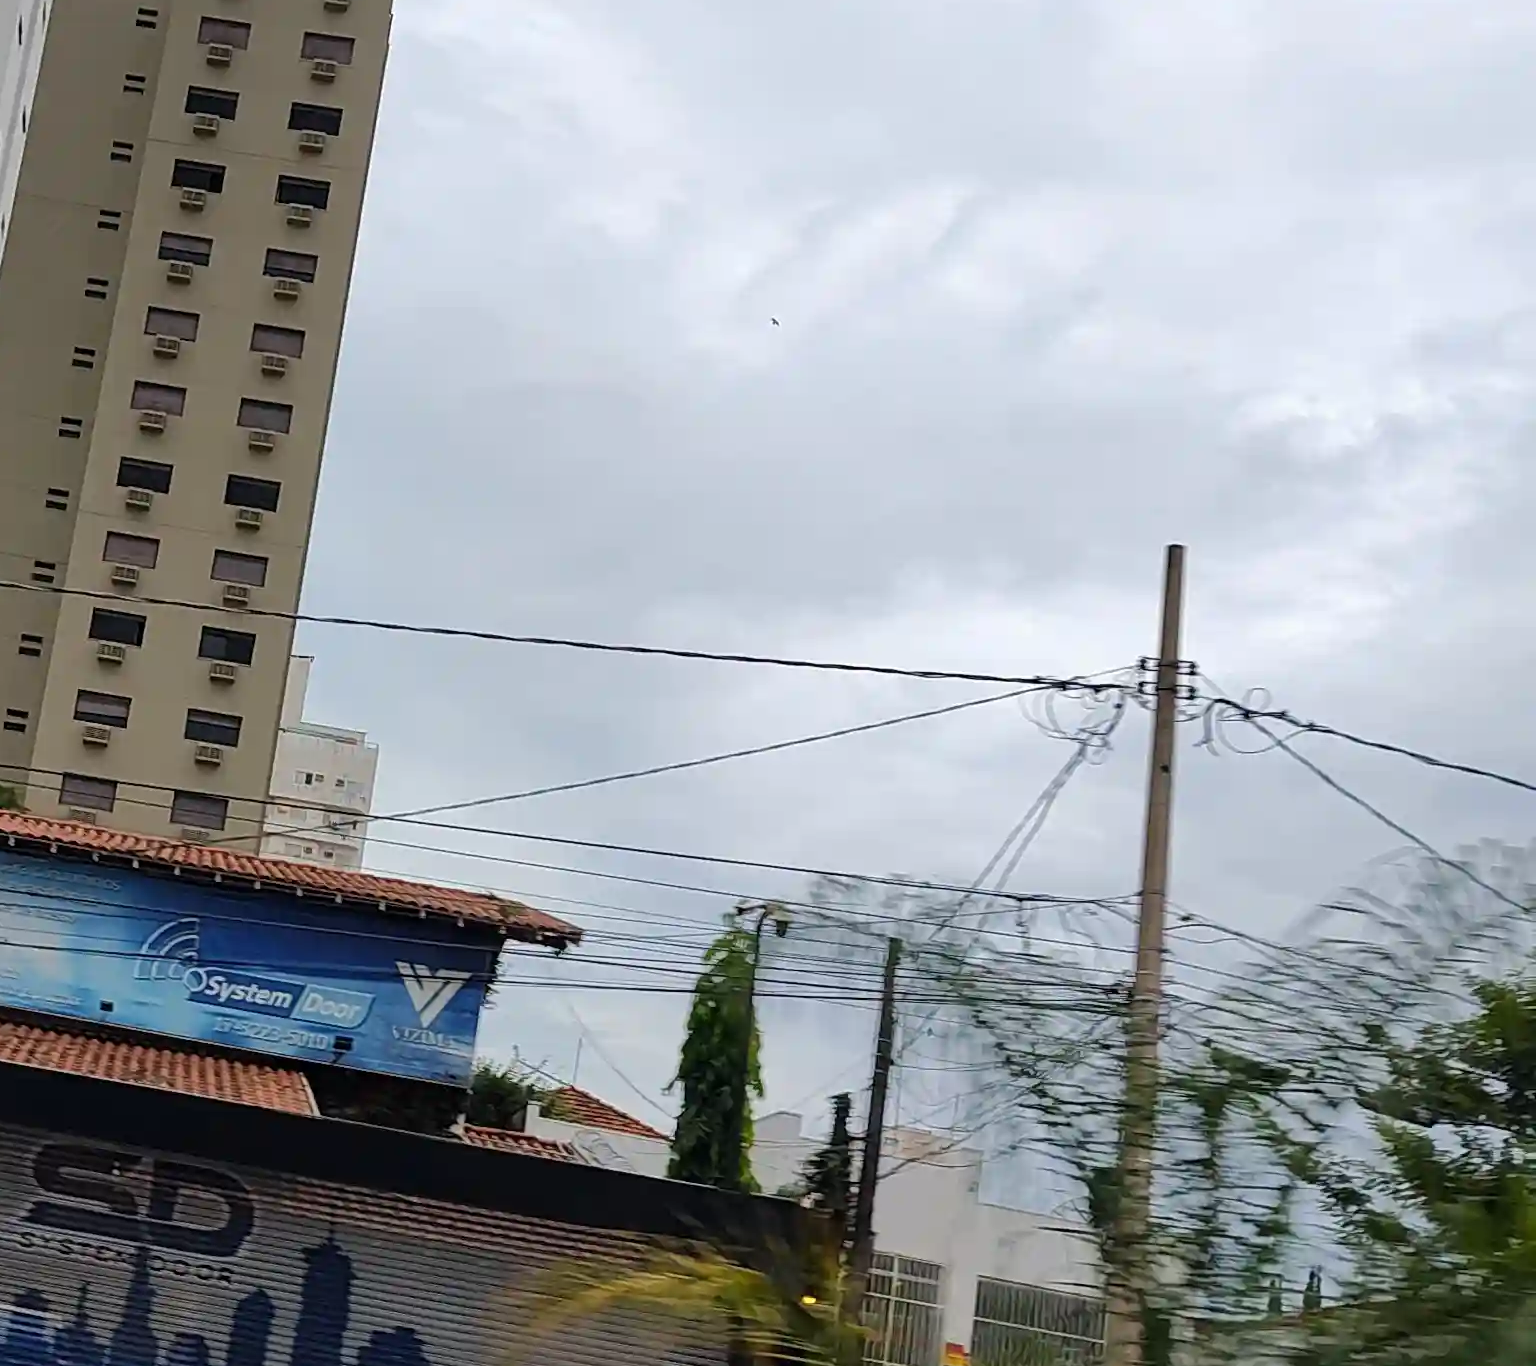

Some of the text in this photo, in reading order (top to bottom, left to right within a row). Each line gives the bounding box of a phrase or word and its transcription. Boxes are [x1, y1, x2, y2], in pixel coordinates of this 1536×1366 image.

[204, 975, 362, 1019] System Door
[20, 1142, 255, 1258] SD
[148, 1251, 233, 1286] DOOR
